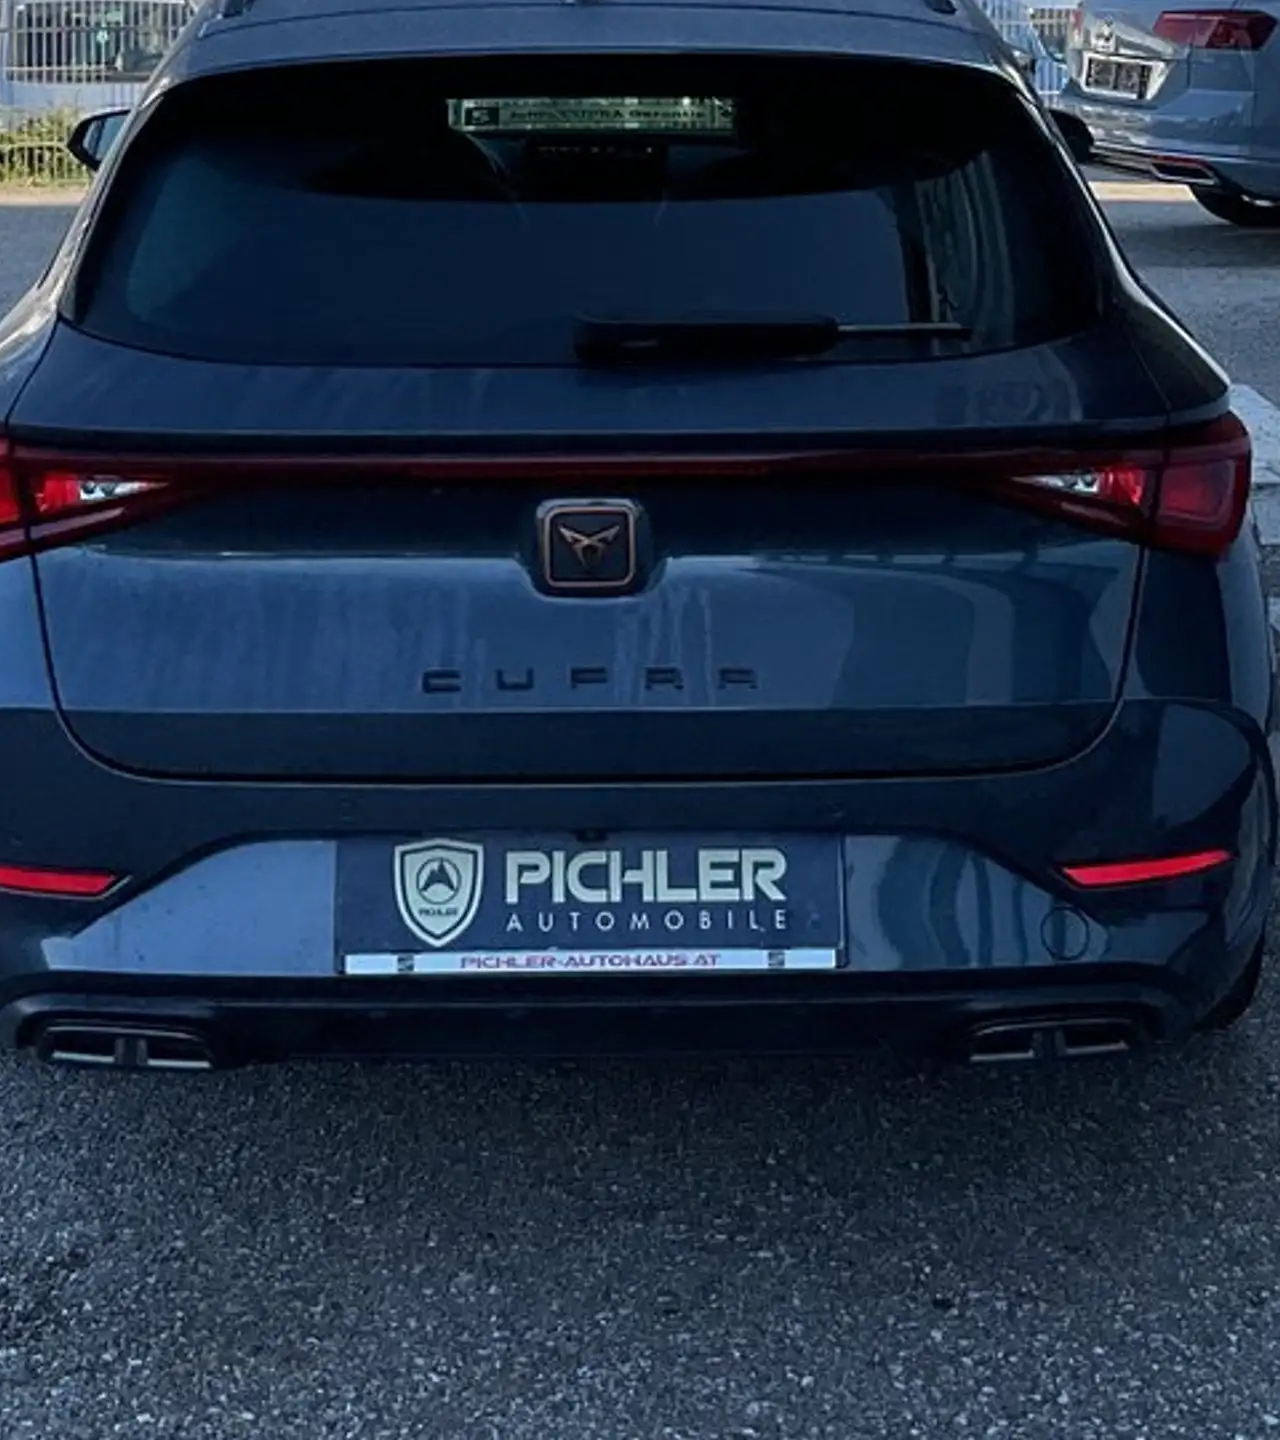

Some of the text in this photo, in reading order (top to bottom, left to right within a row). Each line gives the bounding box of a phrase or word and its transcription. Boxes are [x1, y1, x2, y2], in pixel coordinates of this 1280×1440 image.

[422, 667, 758, 694] CUPRA
[506, 849, 788, 904] PICHLER
[506, 909, 788, 933] AUTOMOBILE
[460, 953, 721, 969] PICHLER-AUTOHAUS.AT
